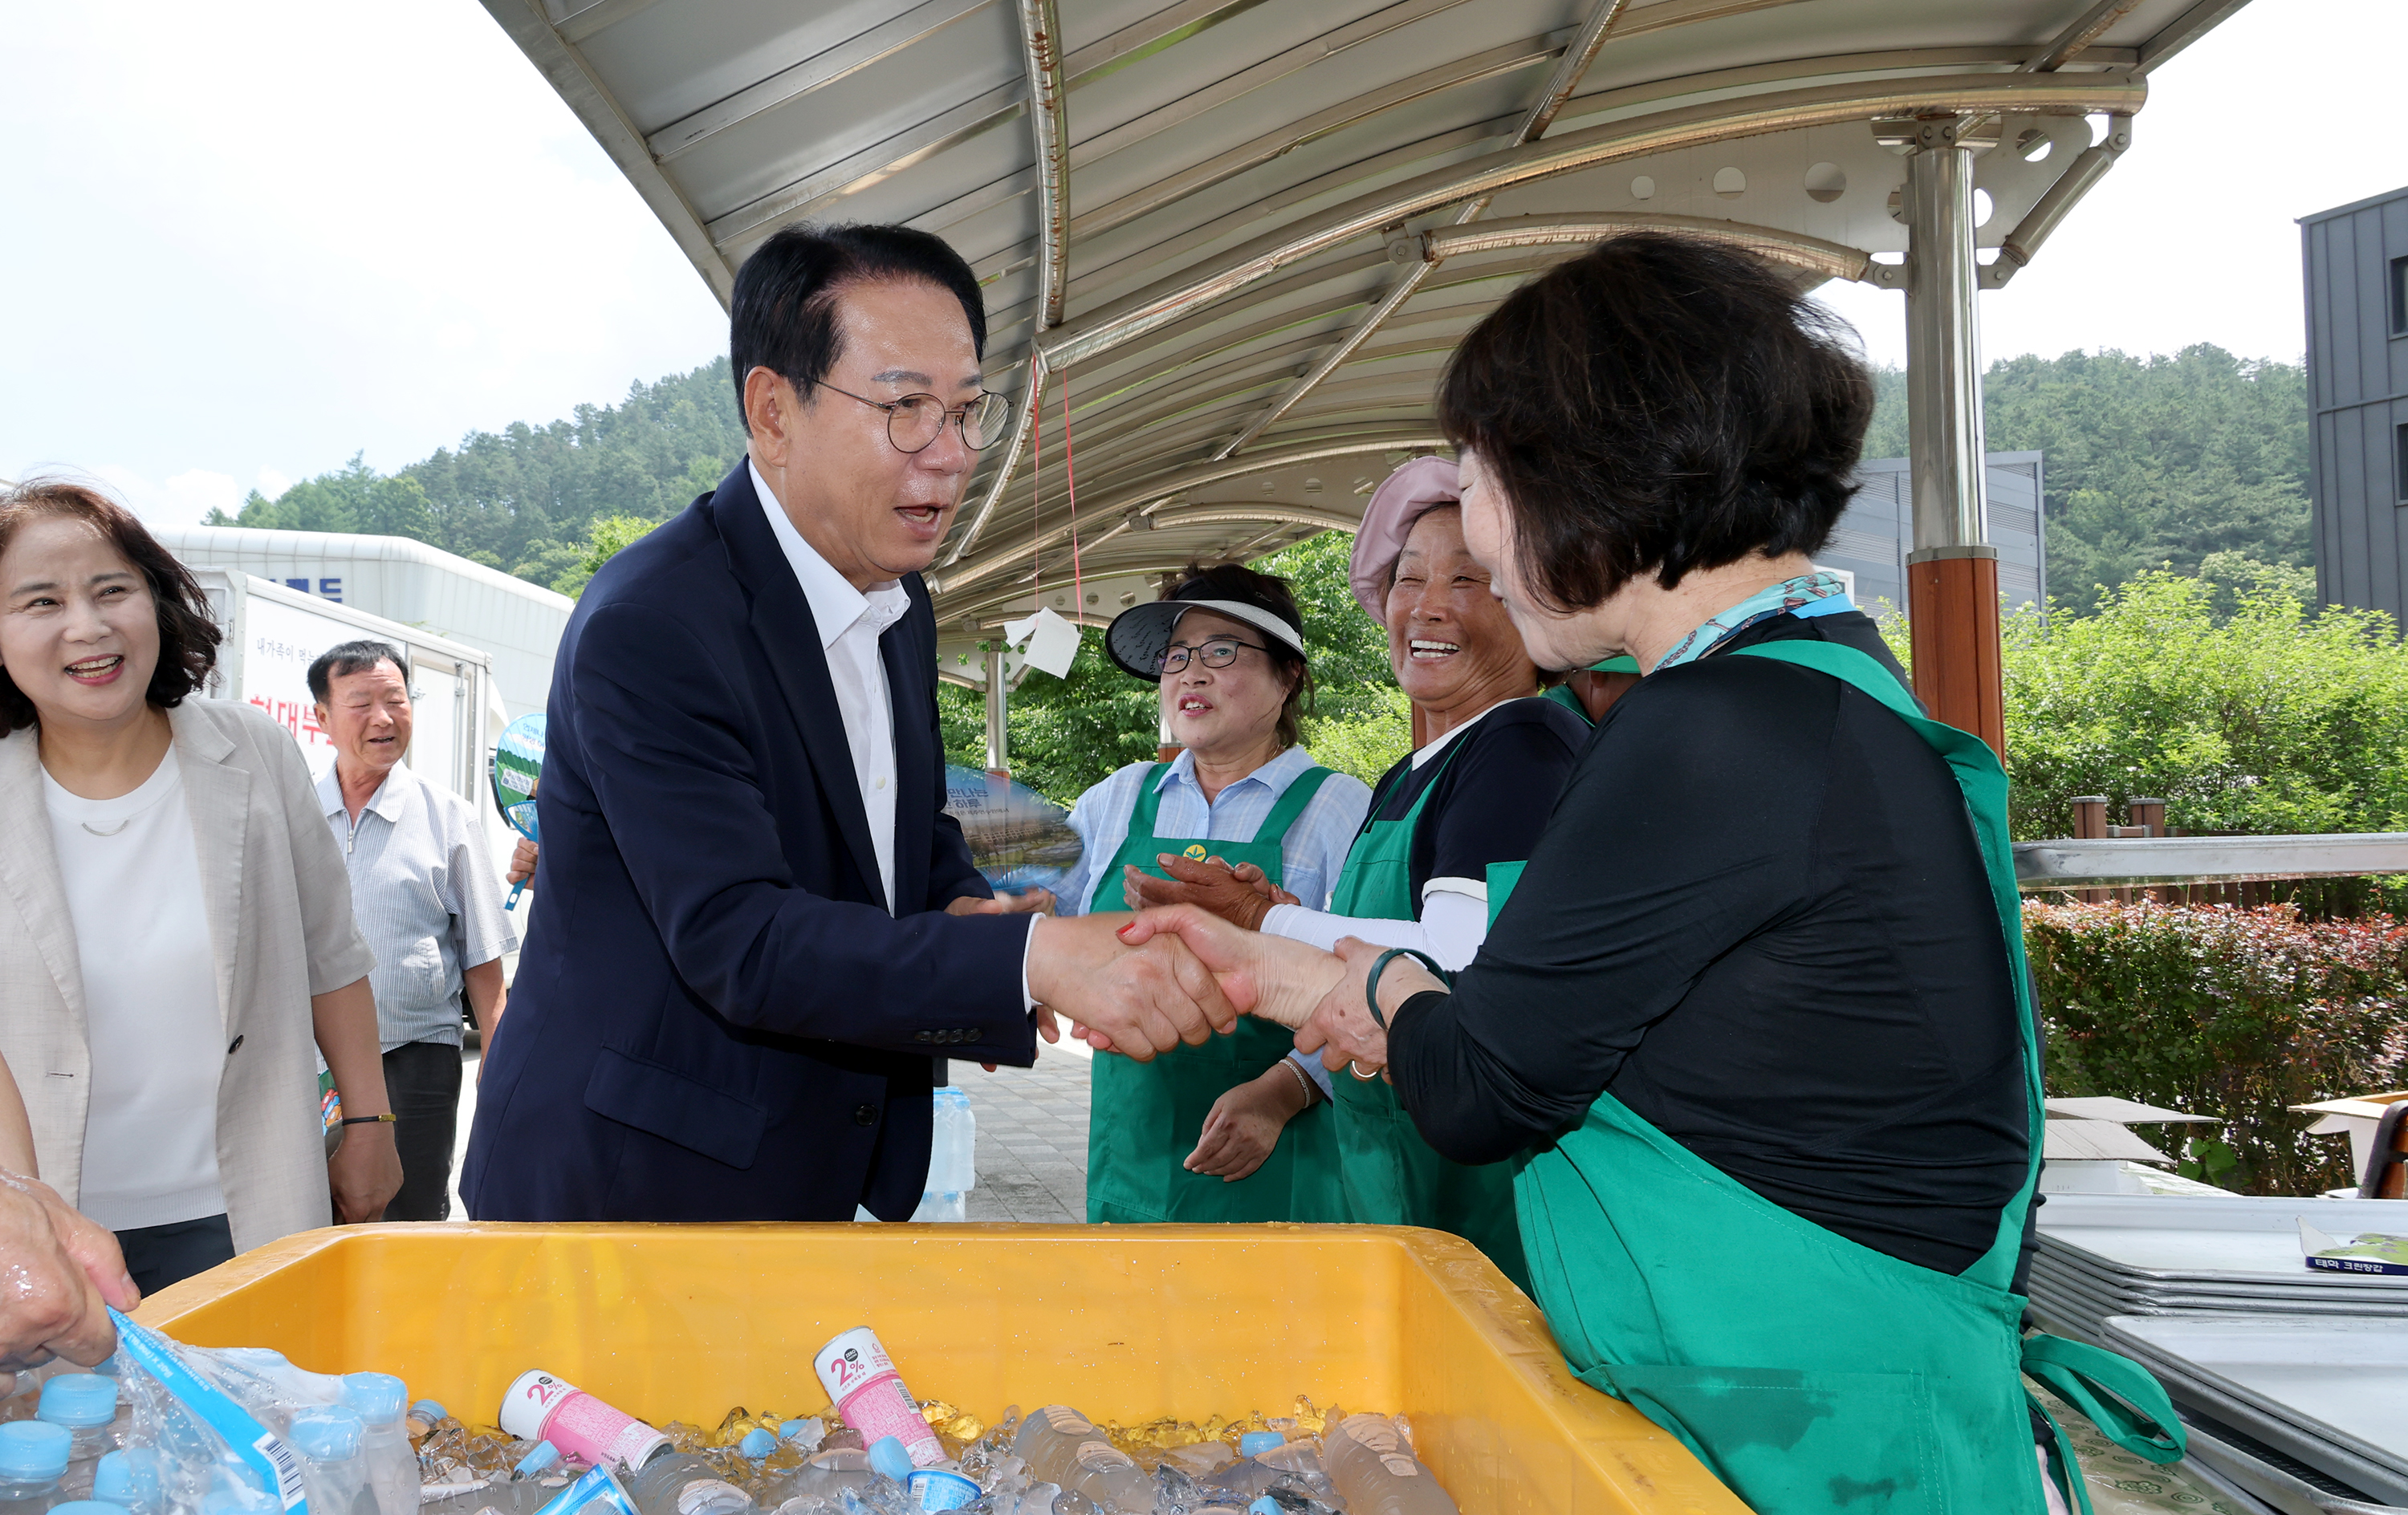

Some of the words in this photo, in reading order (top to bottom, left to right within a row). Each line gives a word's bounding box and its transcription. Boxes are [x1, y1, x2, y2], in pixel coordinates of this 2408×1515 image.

[257, 637, 294, 663] 내가족이
[2315, 1259, 2340, 1269] 태화
[2343, 1261, 2384, 1273] 크린장갑
[166, 1351, 210, 1391] HARDNESS
[831, 1358, 864, 1387] 2%
[527, 1383, 563, 1407] 2%
